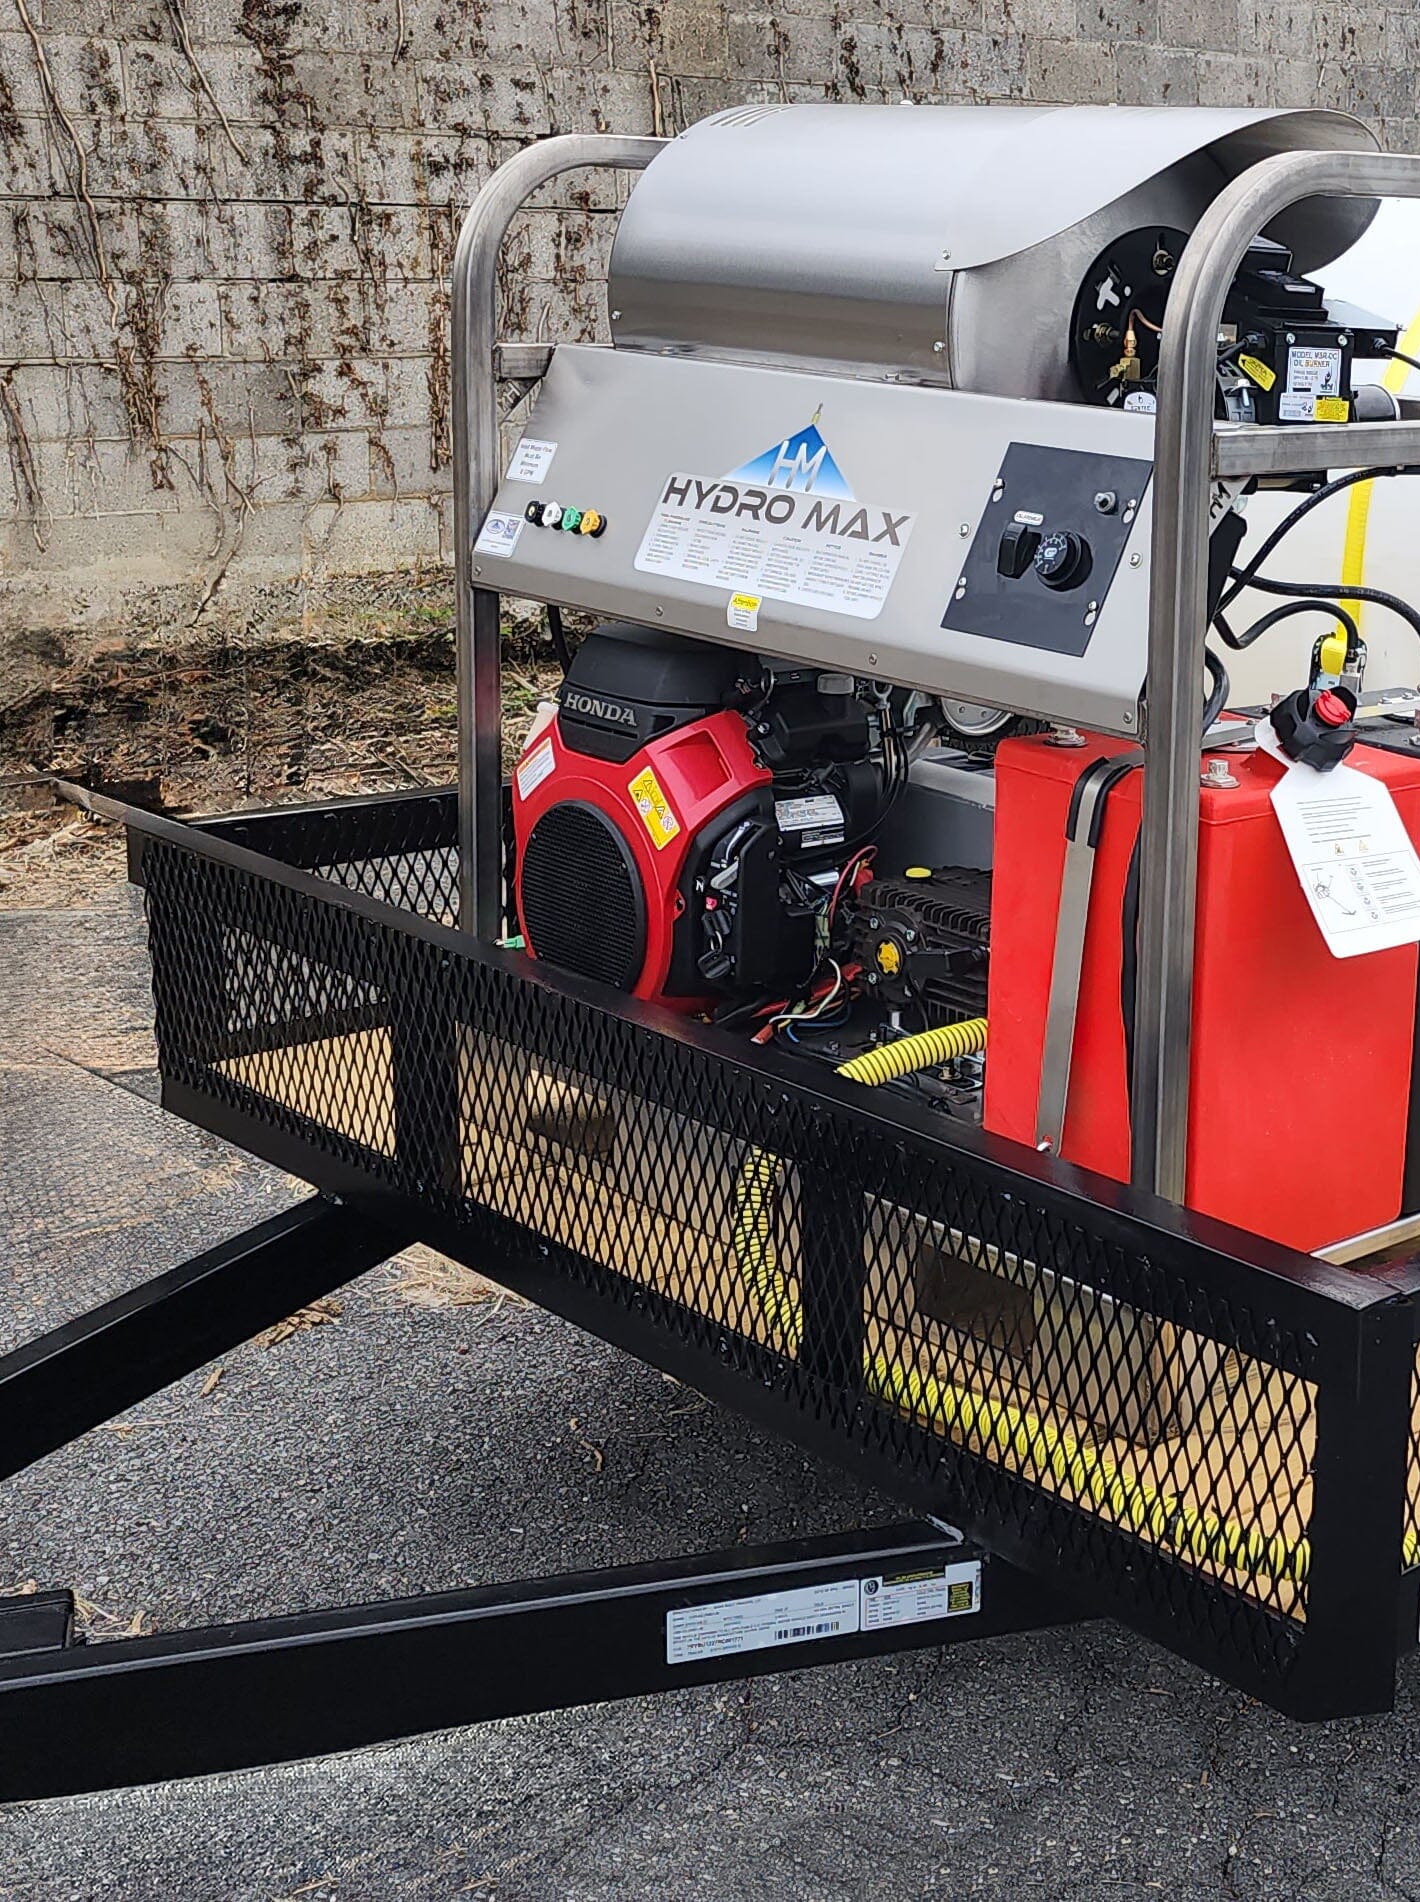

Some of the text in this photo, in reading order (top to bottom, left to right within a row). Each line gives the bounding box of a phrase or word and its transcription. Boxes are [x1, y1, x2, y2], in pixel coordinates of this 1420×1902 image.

[1291, 351, 1312, 359] MODEL
[767, 440, 827, 493] HM
[661, 475, 911, 547] HYDRO MAX
[563, 691, 638, 727] HONDA
